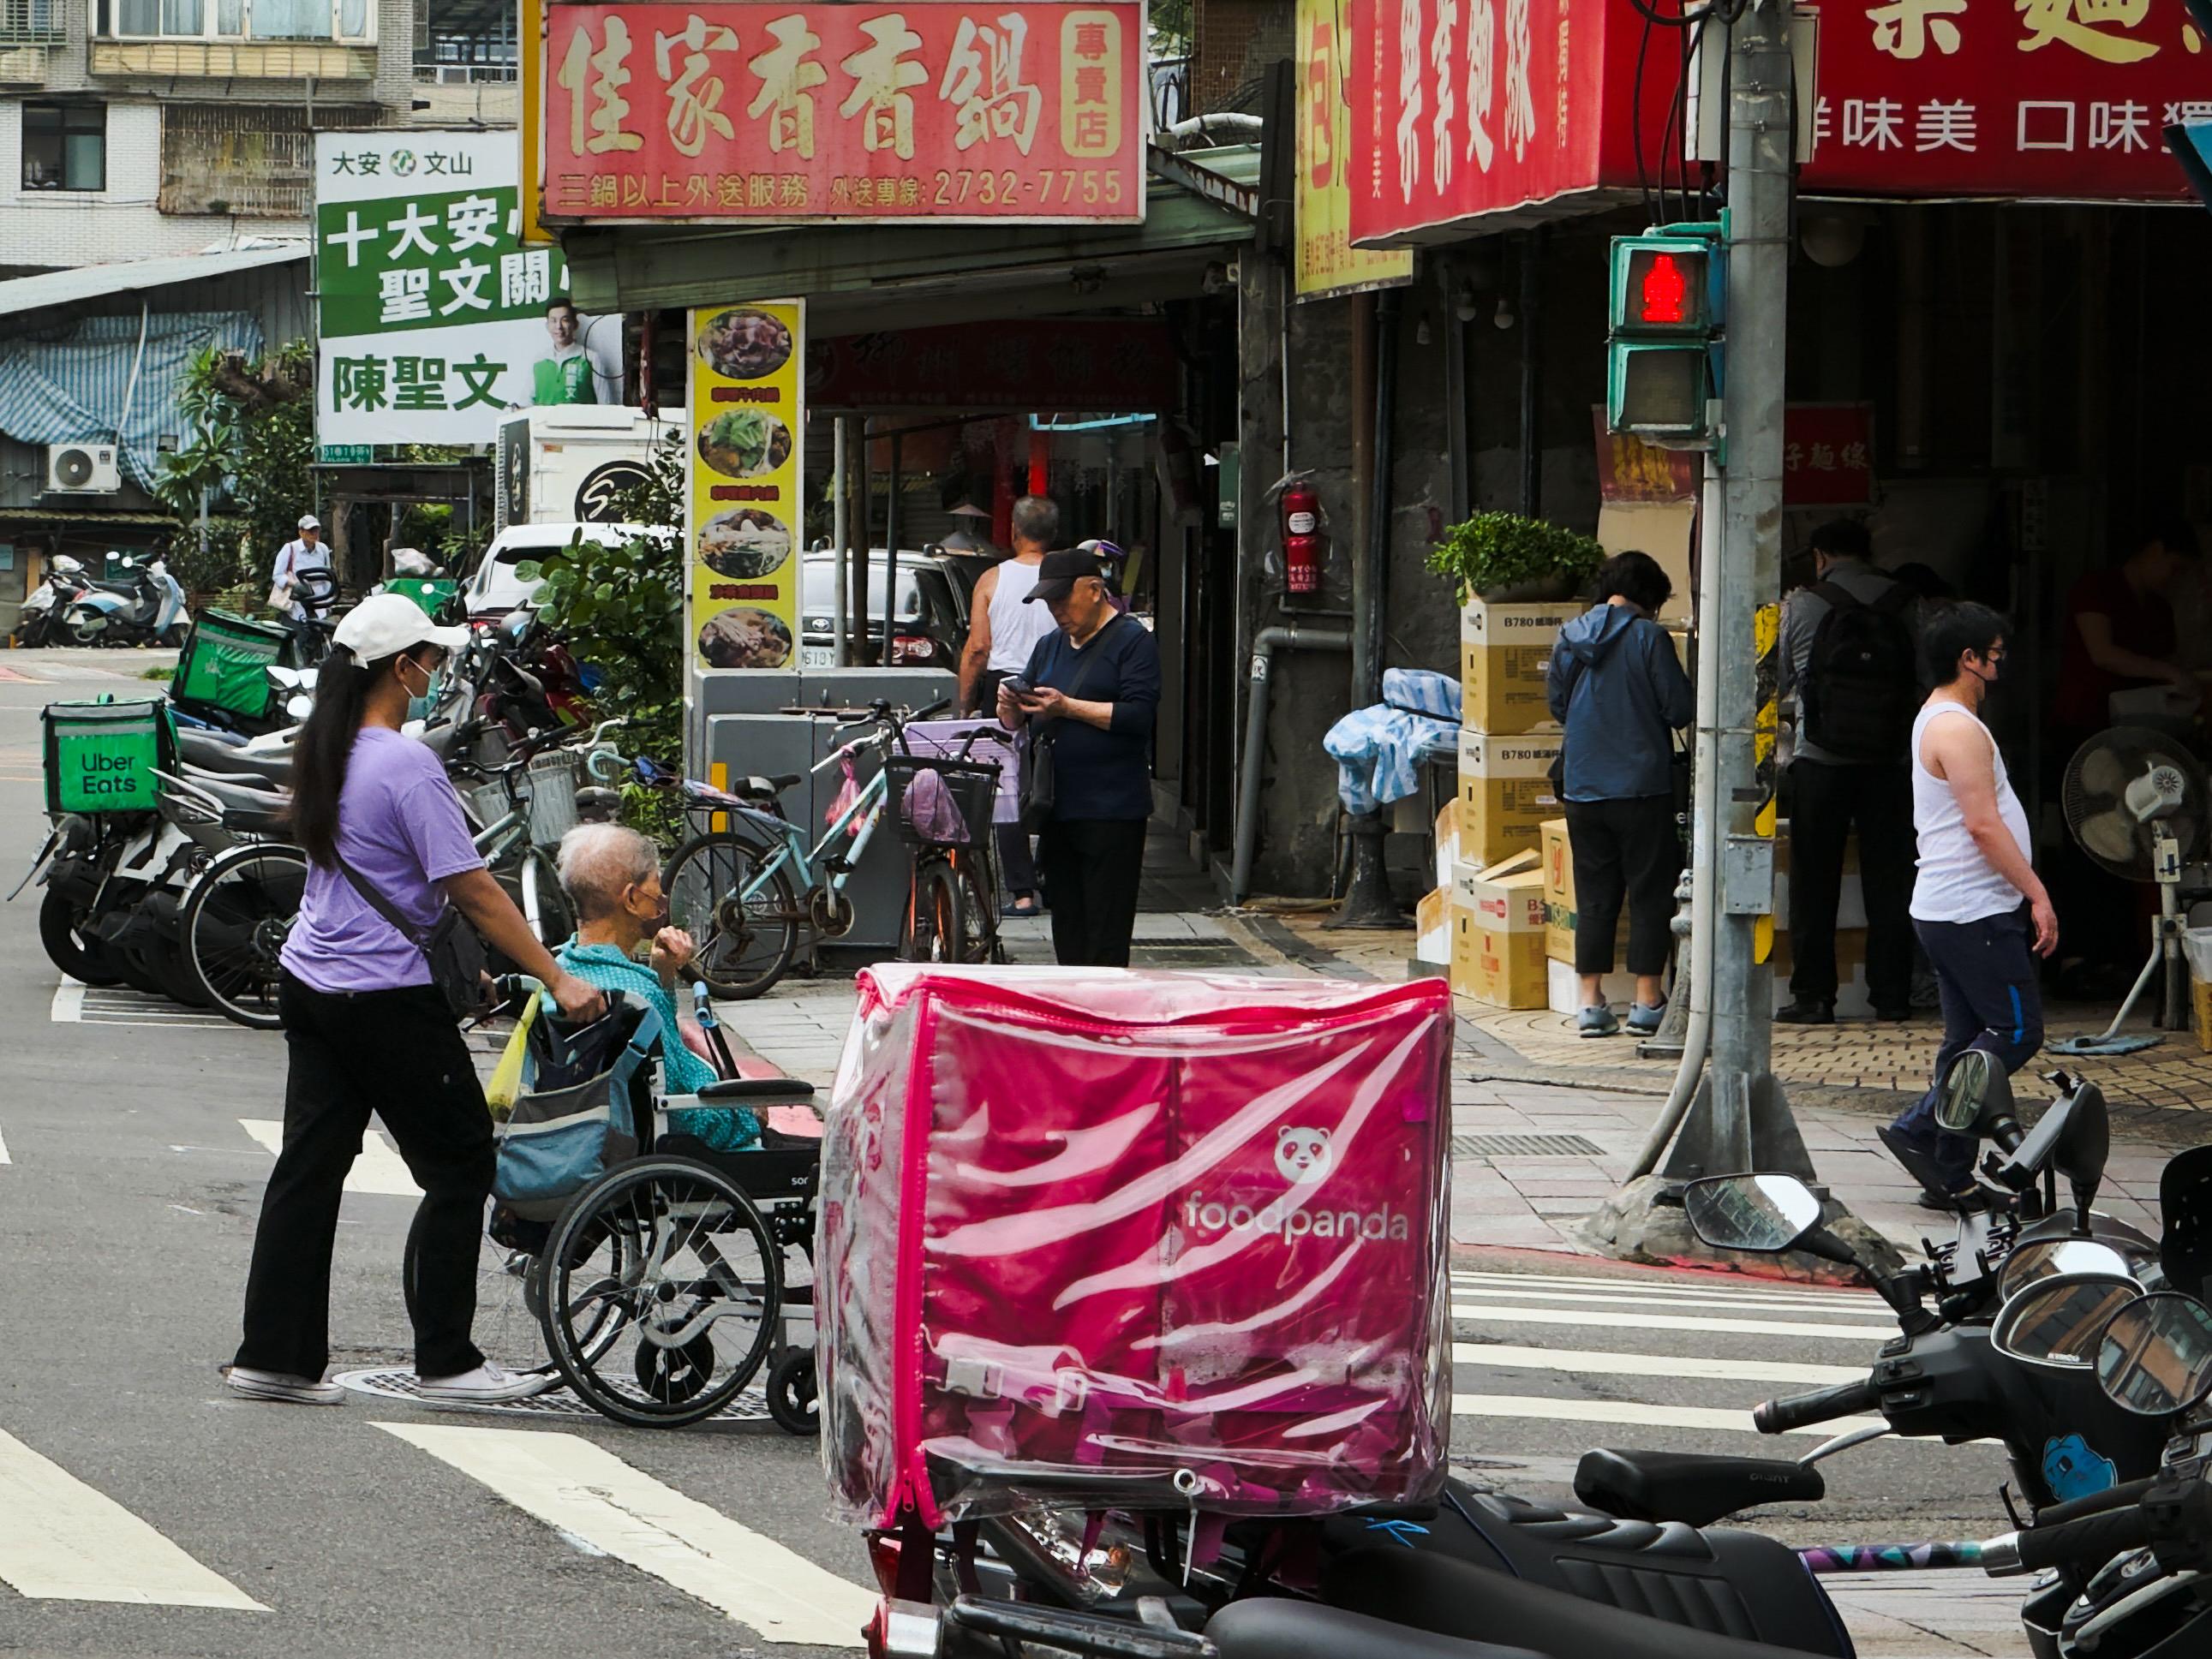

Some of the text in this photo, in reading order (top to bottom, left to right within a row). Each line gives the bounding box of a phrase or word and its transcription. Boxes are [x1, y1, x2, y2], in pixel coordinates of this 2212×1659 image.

[557, 13, 1044, 160] 佳家香香鍋
[1073, 22, 1109, 148] 專賣店
[332, 151, 472, 176] 大安 文山
[559, 174, 810, 209] 三鍋以上外送服務
[935, 170, 1122, 206] 2732-7755
[326, 195, 517, 268] 十大安
[380, 249, 568, 323] 聖文關
[333, 354, 507, 412] 陳聖文
[1504, 617, 1533, 627] B780
[82, 754, 135, 772] Uber
[1502, 749, 1531, 760] B780
[82, 775, 137, 794] Eats
[1186, 1191, 1408, 1245] foodpanda
